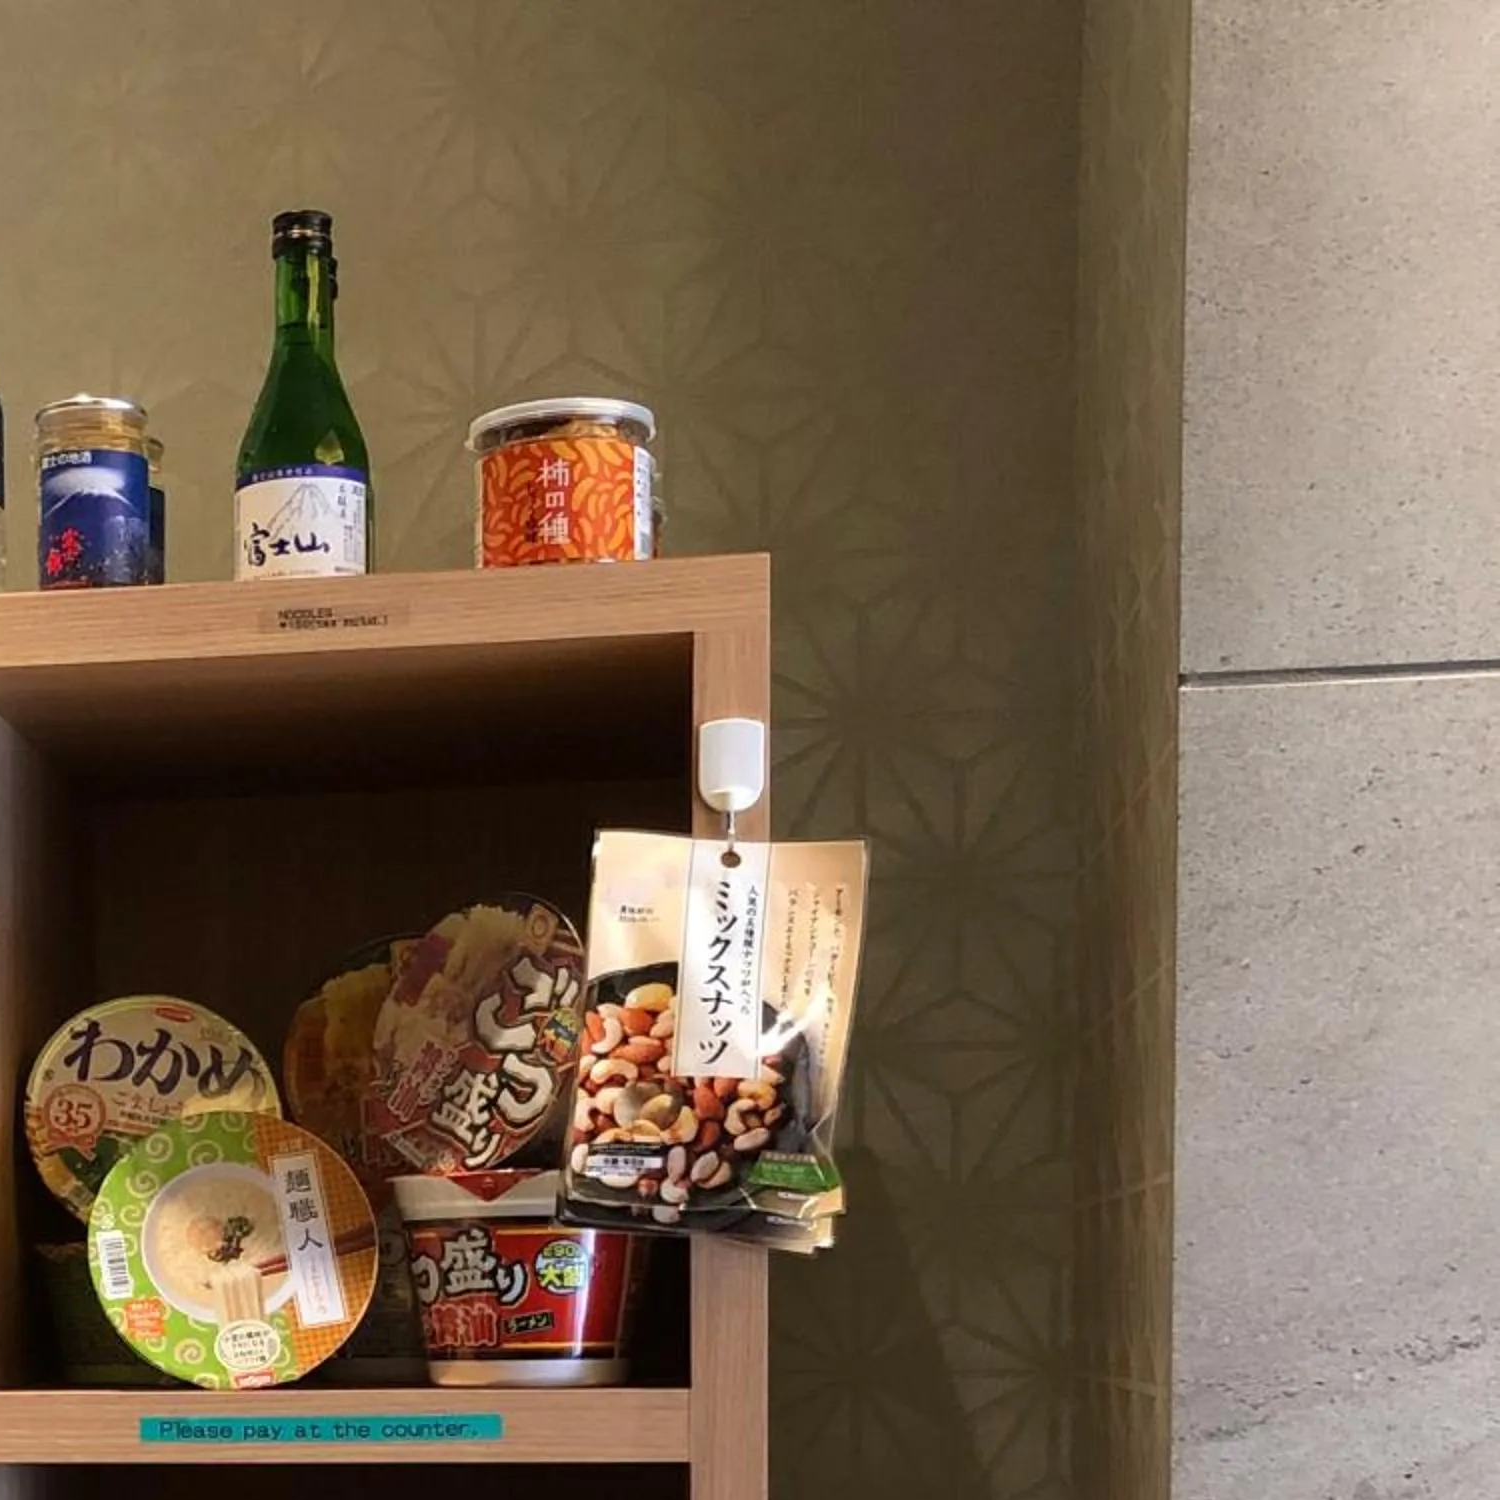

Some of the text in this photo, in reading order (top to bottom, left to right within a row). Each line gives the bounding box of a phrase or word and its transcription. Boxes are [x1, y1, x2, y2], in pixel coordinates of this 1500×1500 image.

[536, 457, 572, 545] 柿の種
[243, 521, 331, 567] 富士山
[700, 881, 738, 1066] ミックスナッツ
[63, 1017, 267, 1099] わかめ
[54, 1100, 94, 1129] 35
[285, 1168, 324, 1252] 麺職人
[160, 1421, 478, 1441] Please pay at the counter.
